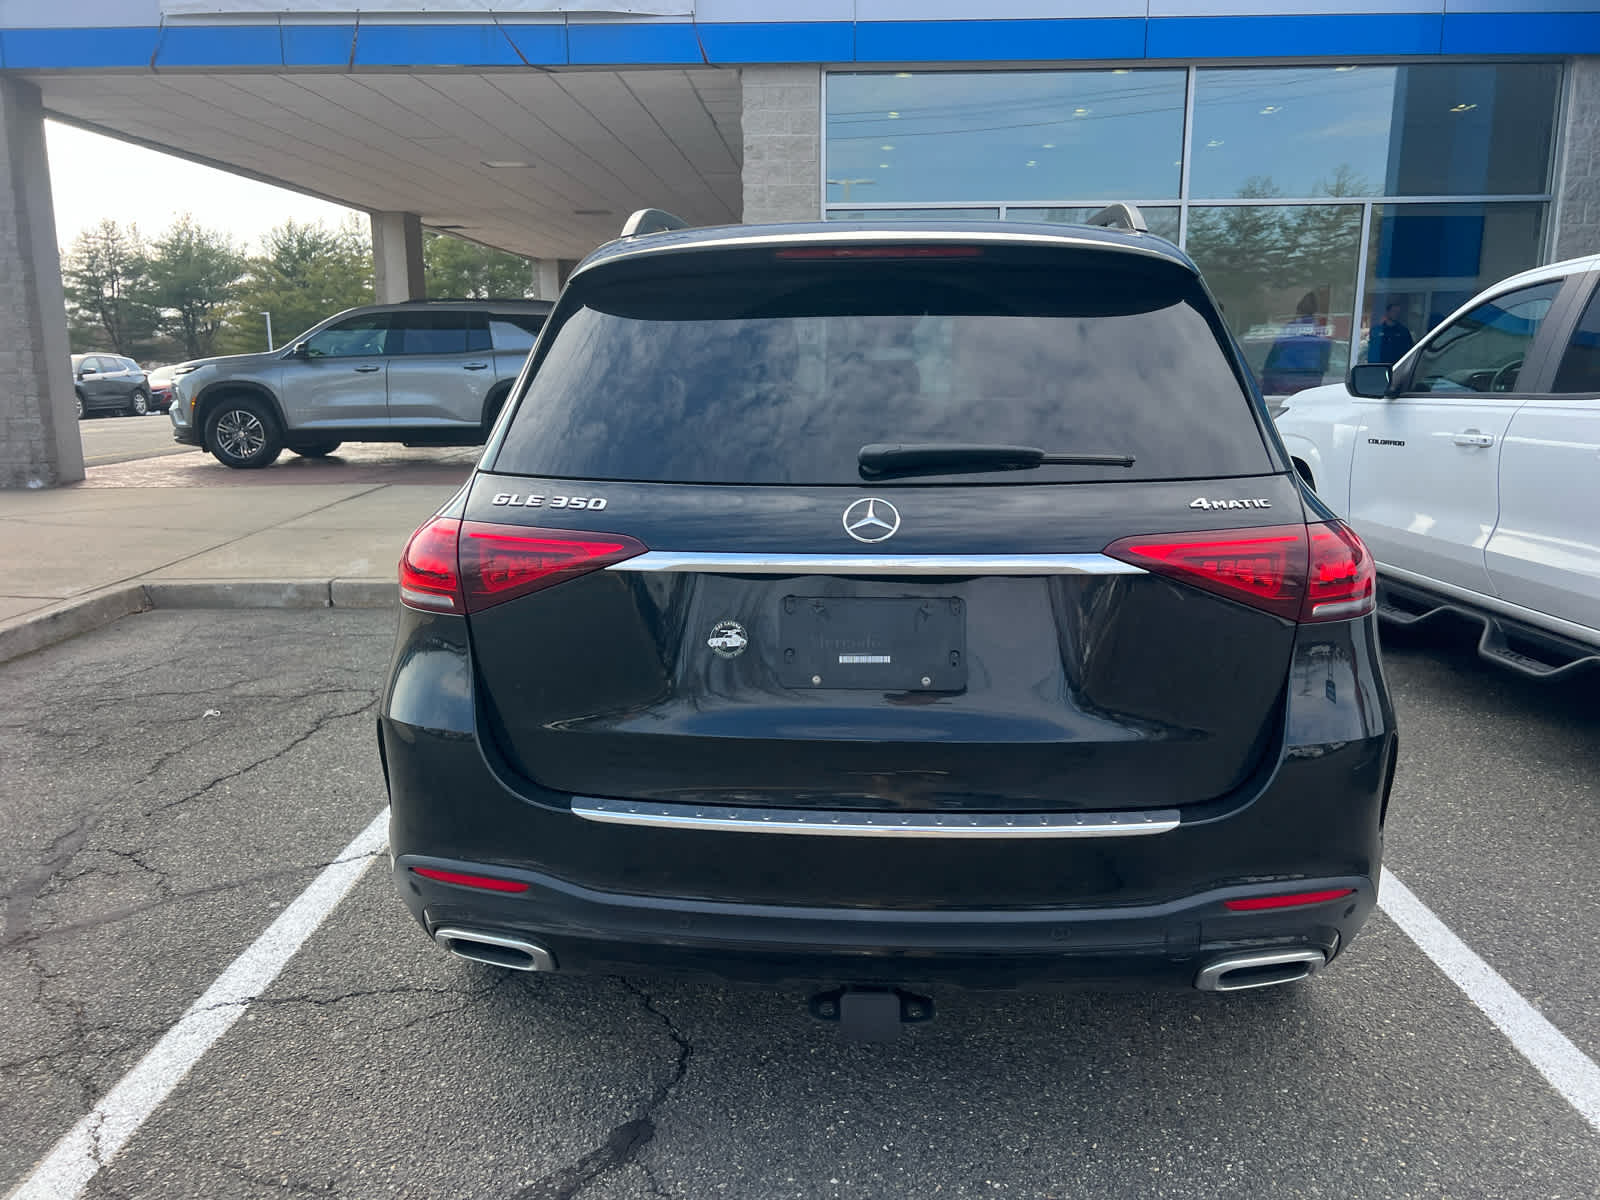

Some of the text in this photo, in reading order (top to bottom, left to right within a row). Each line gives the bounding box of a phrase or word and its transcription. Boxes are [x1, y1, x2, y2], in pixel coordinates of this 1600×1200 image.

[1367, 438, 1406, 447] COLORADO
[492, 493, 608, 511] GLE 350
[1189, 497, 1273, 510] 4MATIC
